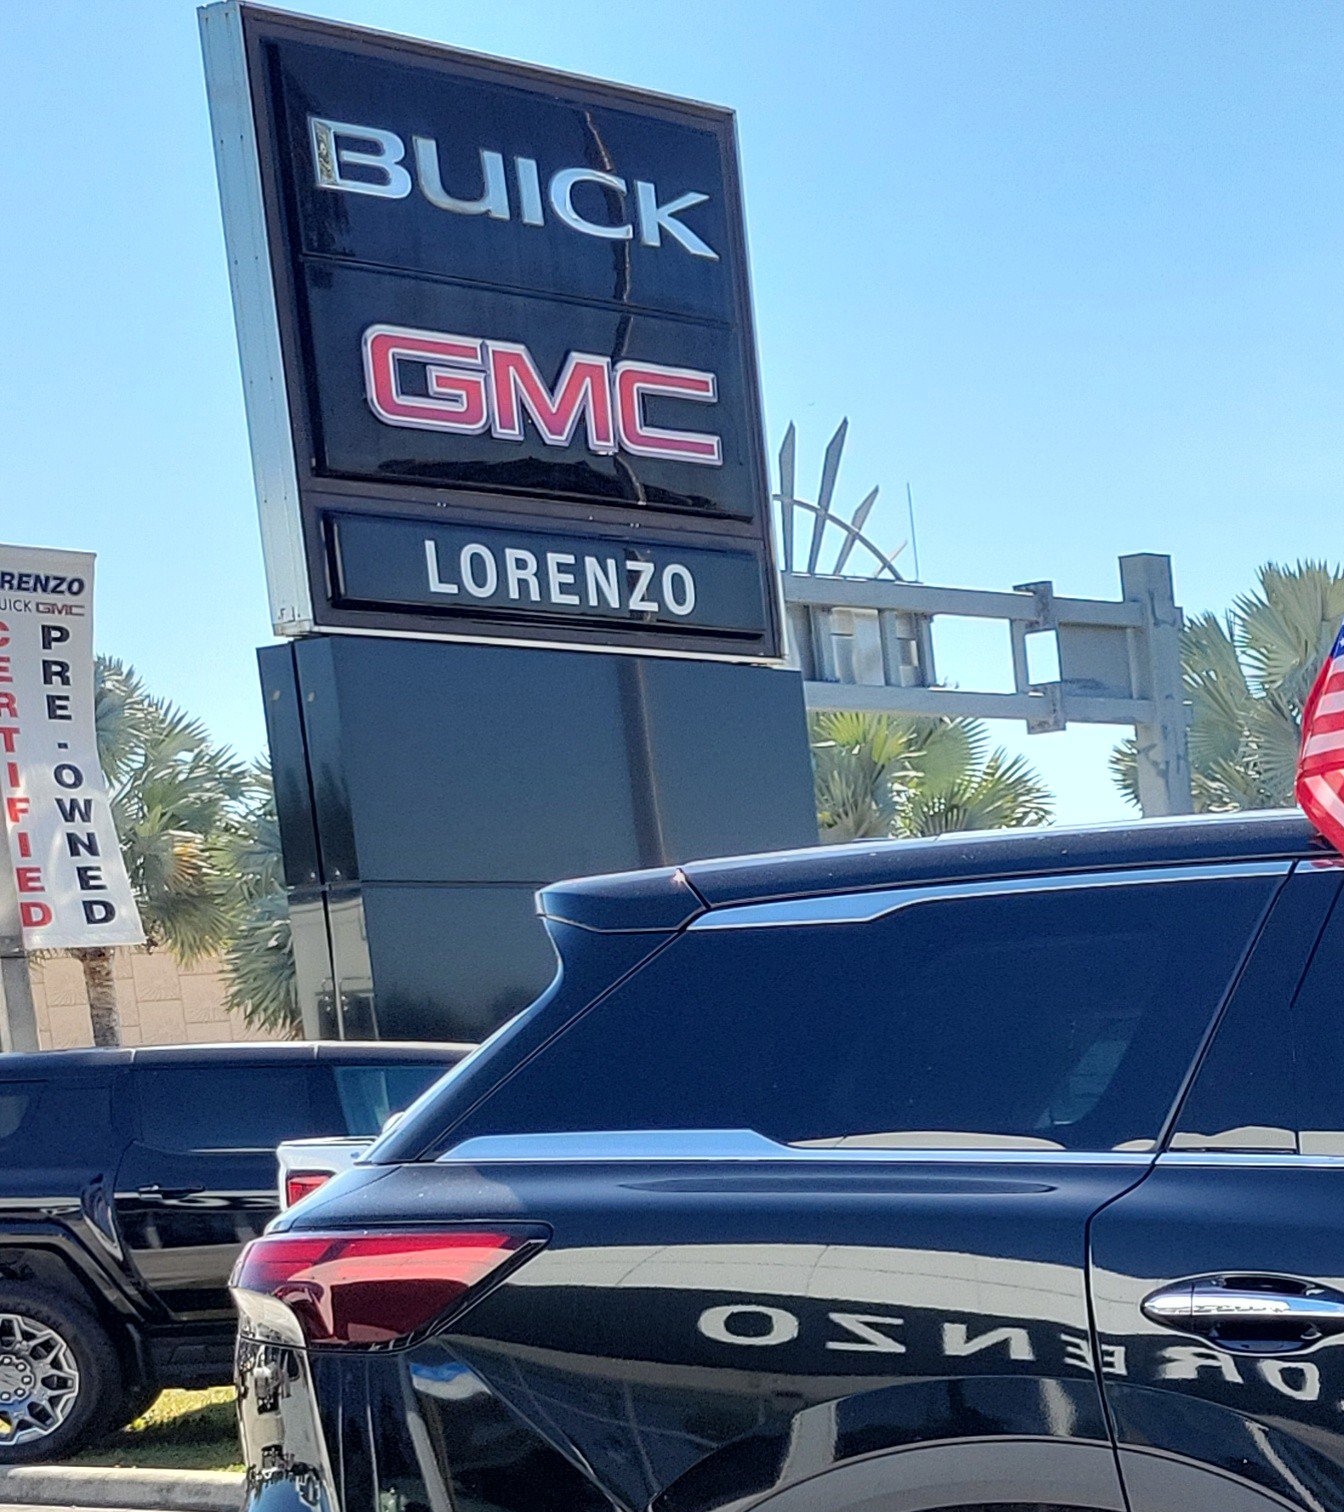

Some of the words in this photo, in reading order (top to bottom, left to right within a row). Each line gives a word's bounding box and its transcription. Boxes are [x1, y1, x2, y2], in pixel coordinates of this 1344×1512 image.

[307, 115, 720, 261] BUICK
[361, 323, 724, 467] GMC
[0, 570, 85, 596] RENZO
[0, 598, 32, 613] UICK
[36, 601, 85, 617] GMC
[423, 539, 697, 616] LORENZO
[41, 624, 116, 925] PRE-OWNED
